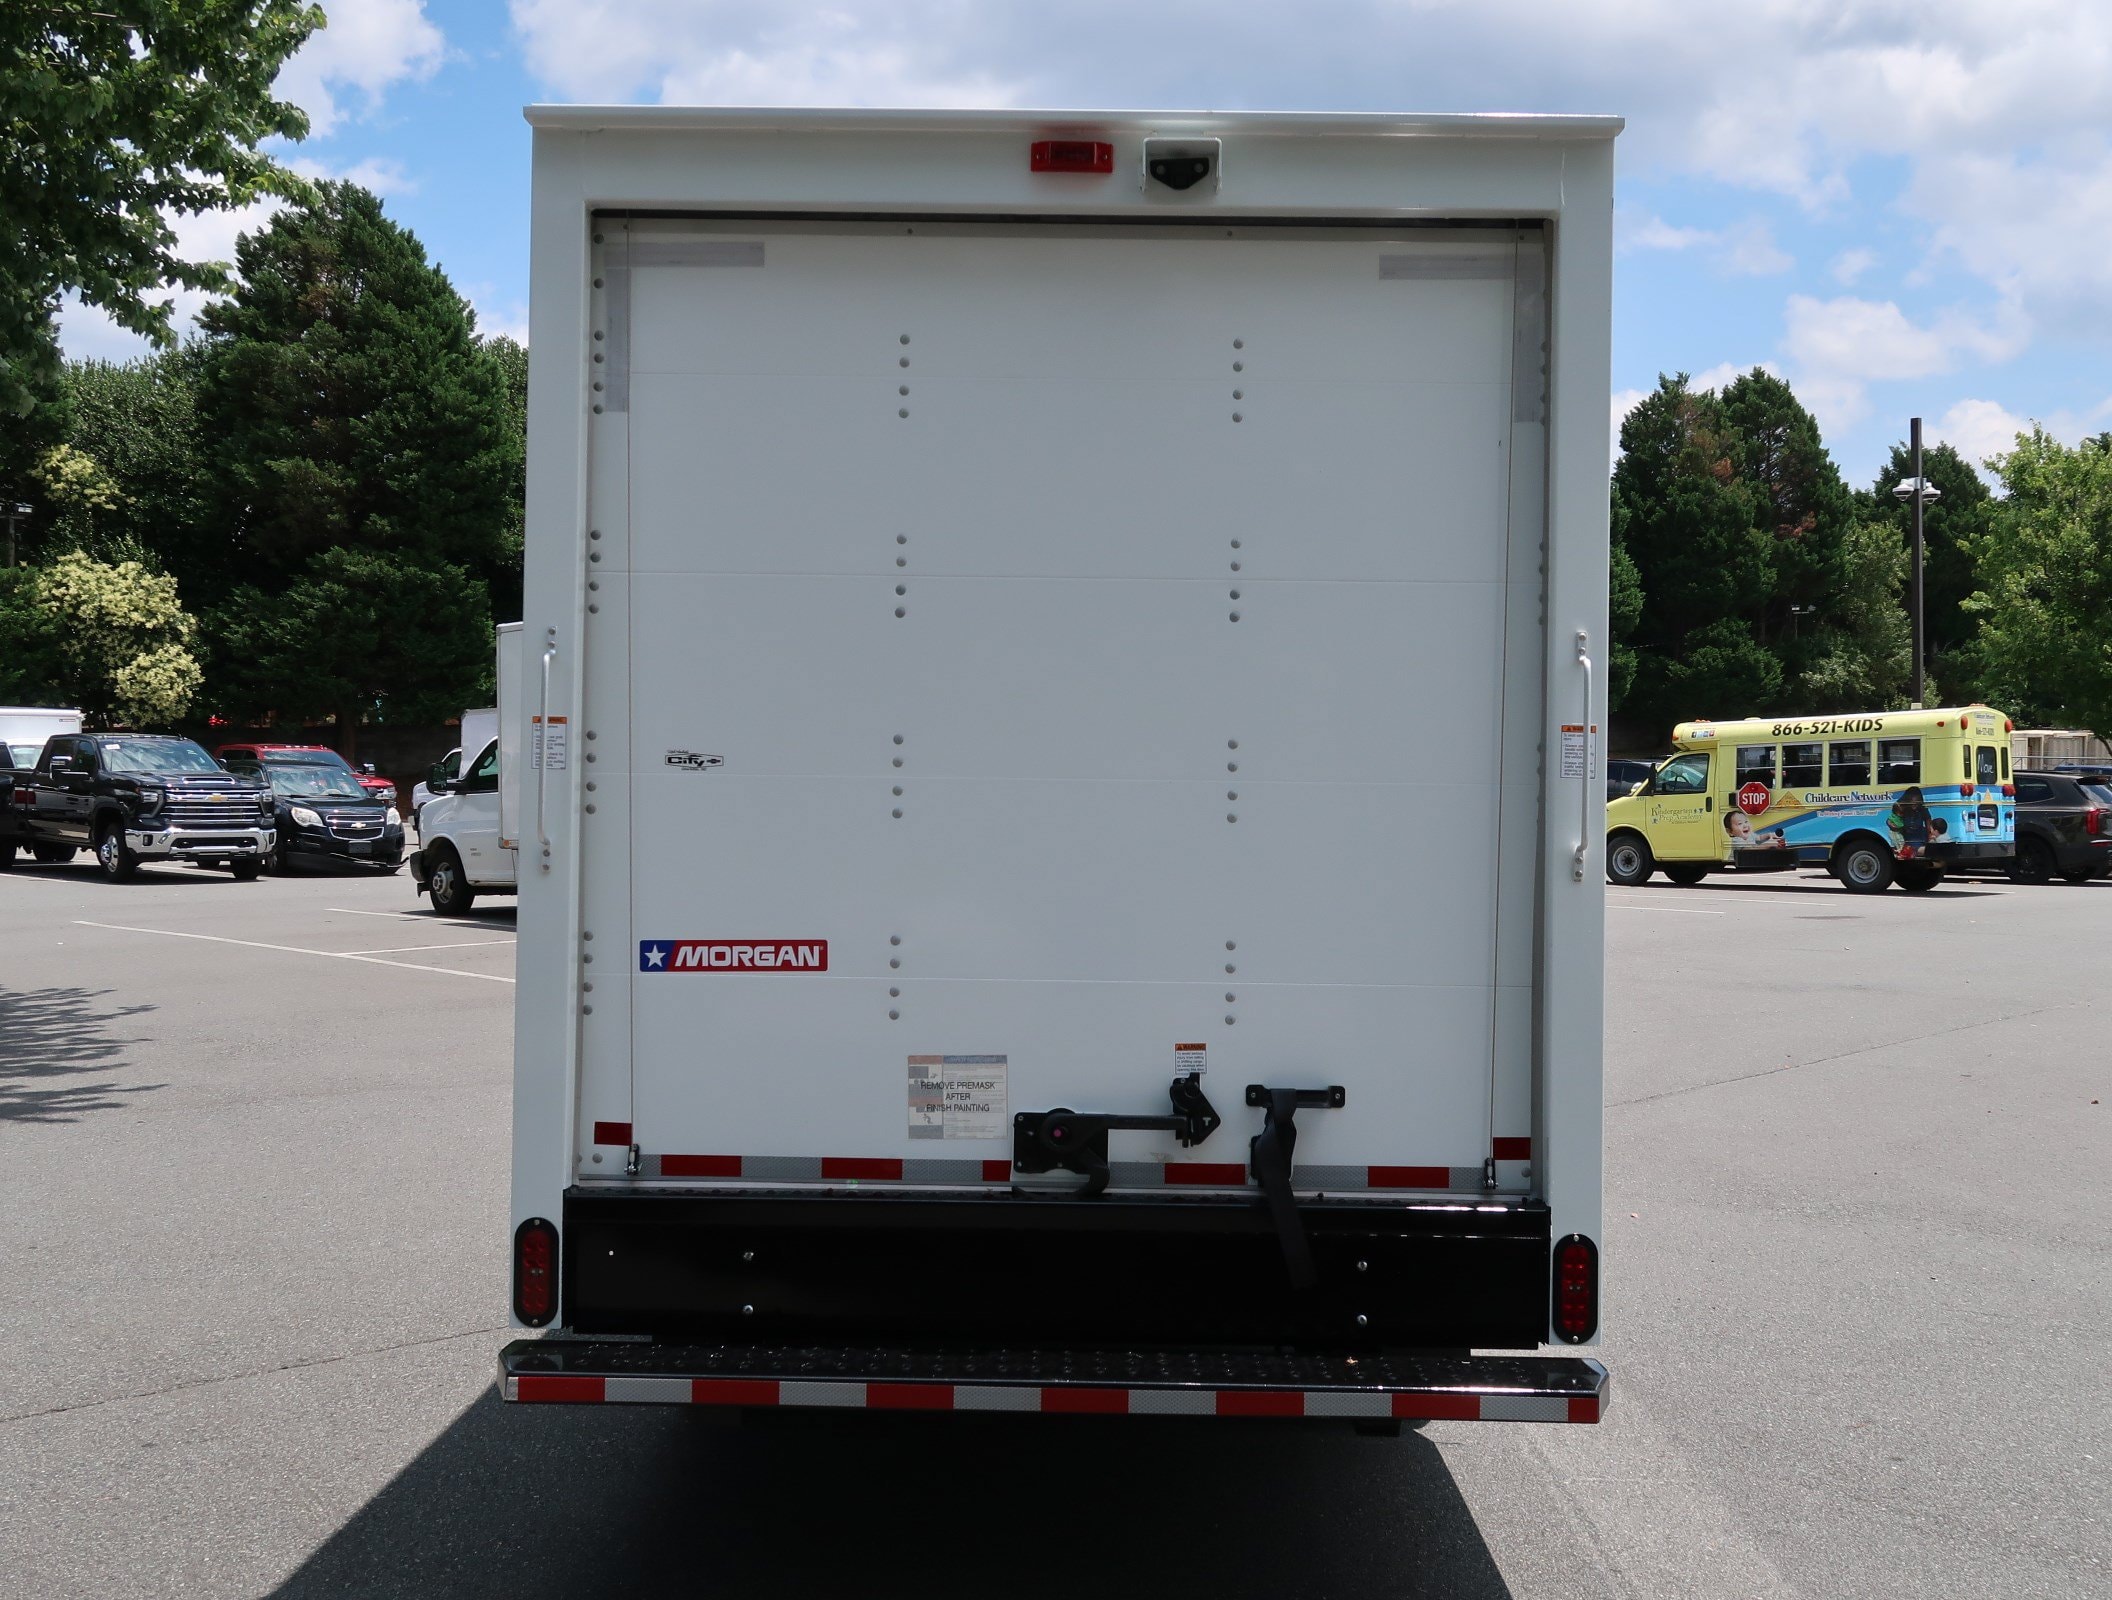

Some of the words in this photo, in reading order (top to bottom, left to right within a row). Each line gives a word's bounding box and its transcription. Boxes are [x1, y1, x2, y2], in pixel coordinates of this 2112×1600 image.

[1772, 718, 1884, 736] 866-521-KIDS
[1742, 792, 1766, 805] STOP
[1805, 792, 1850, 803] Childcare
[1850, 790, 1892, 802] Network
[674, 945, 820, 967] MORGAN
[920, 1081, 955, 1089] REMOVE
[956, 1081, 995, 1089] PREMASK
[926, 1104, 952, 1112] FINISH
[953, 1104, 990, 1112] PAINTING
